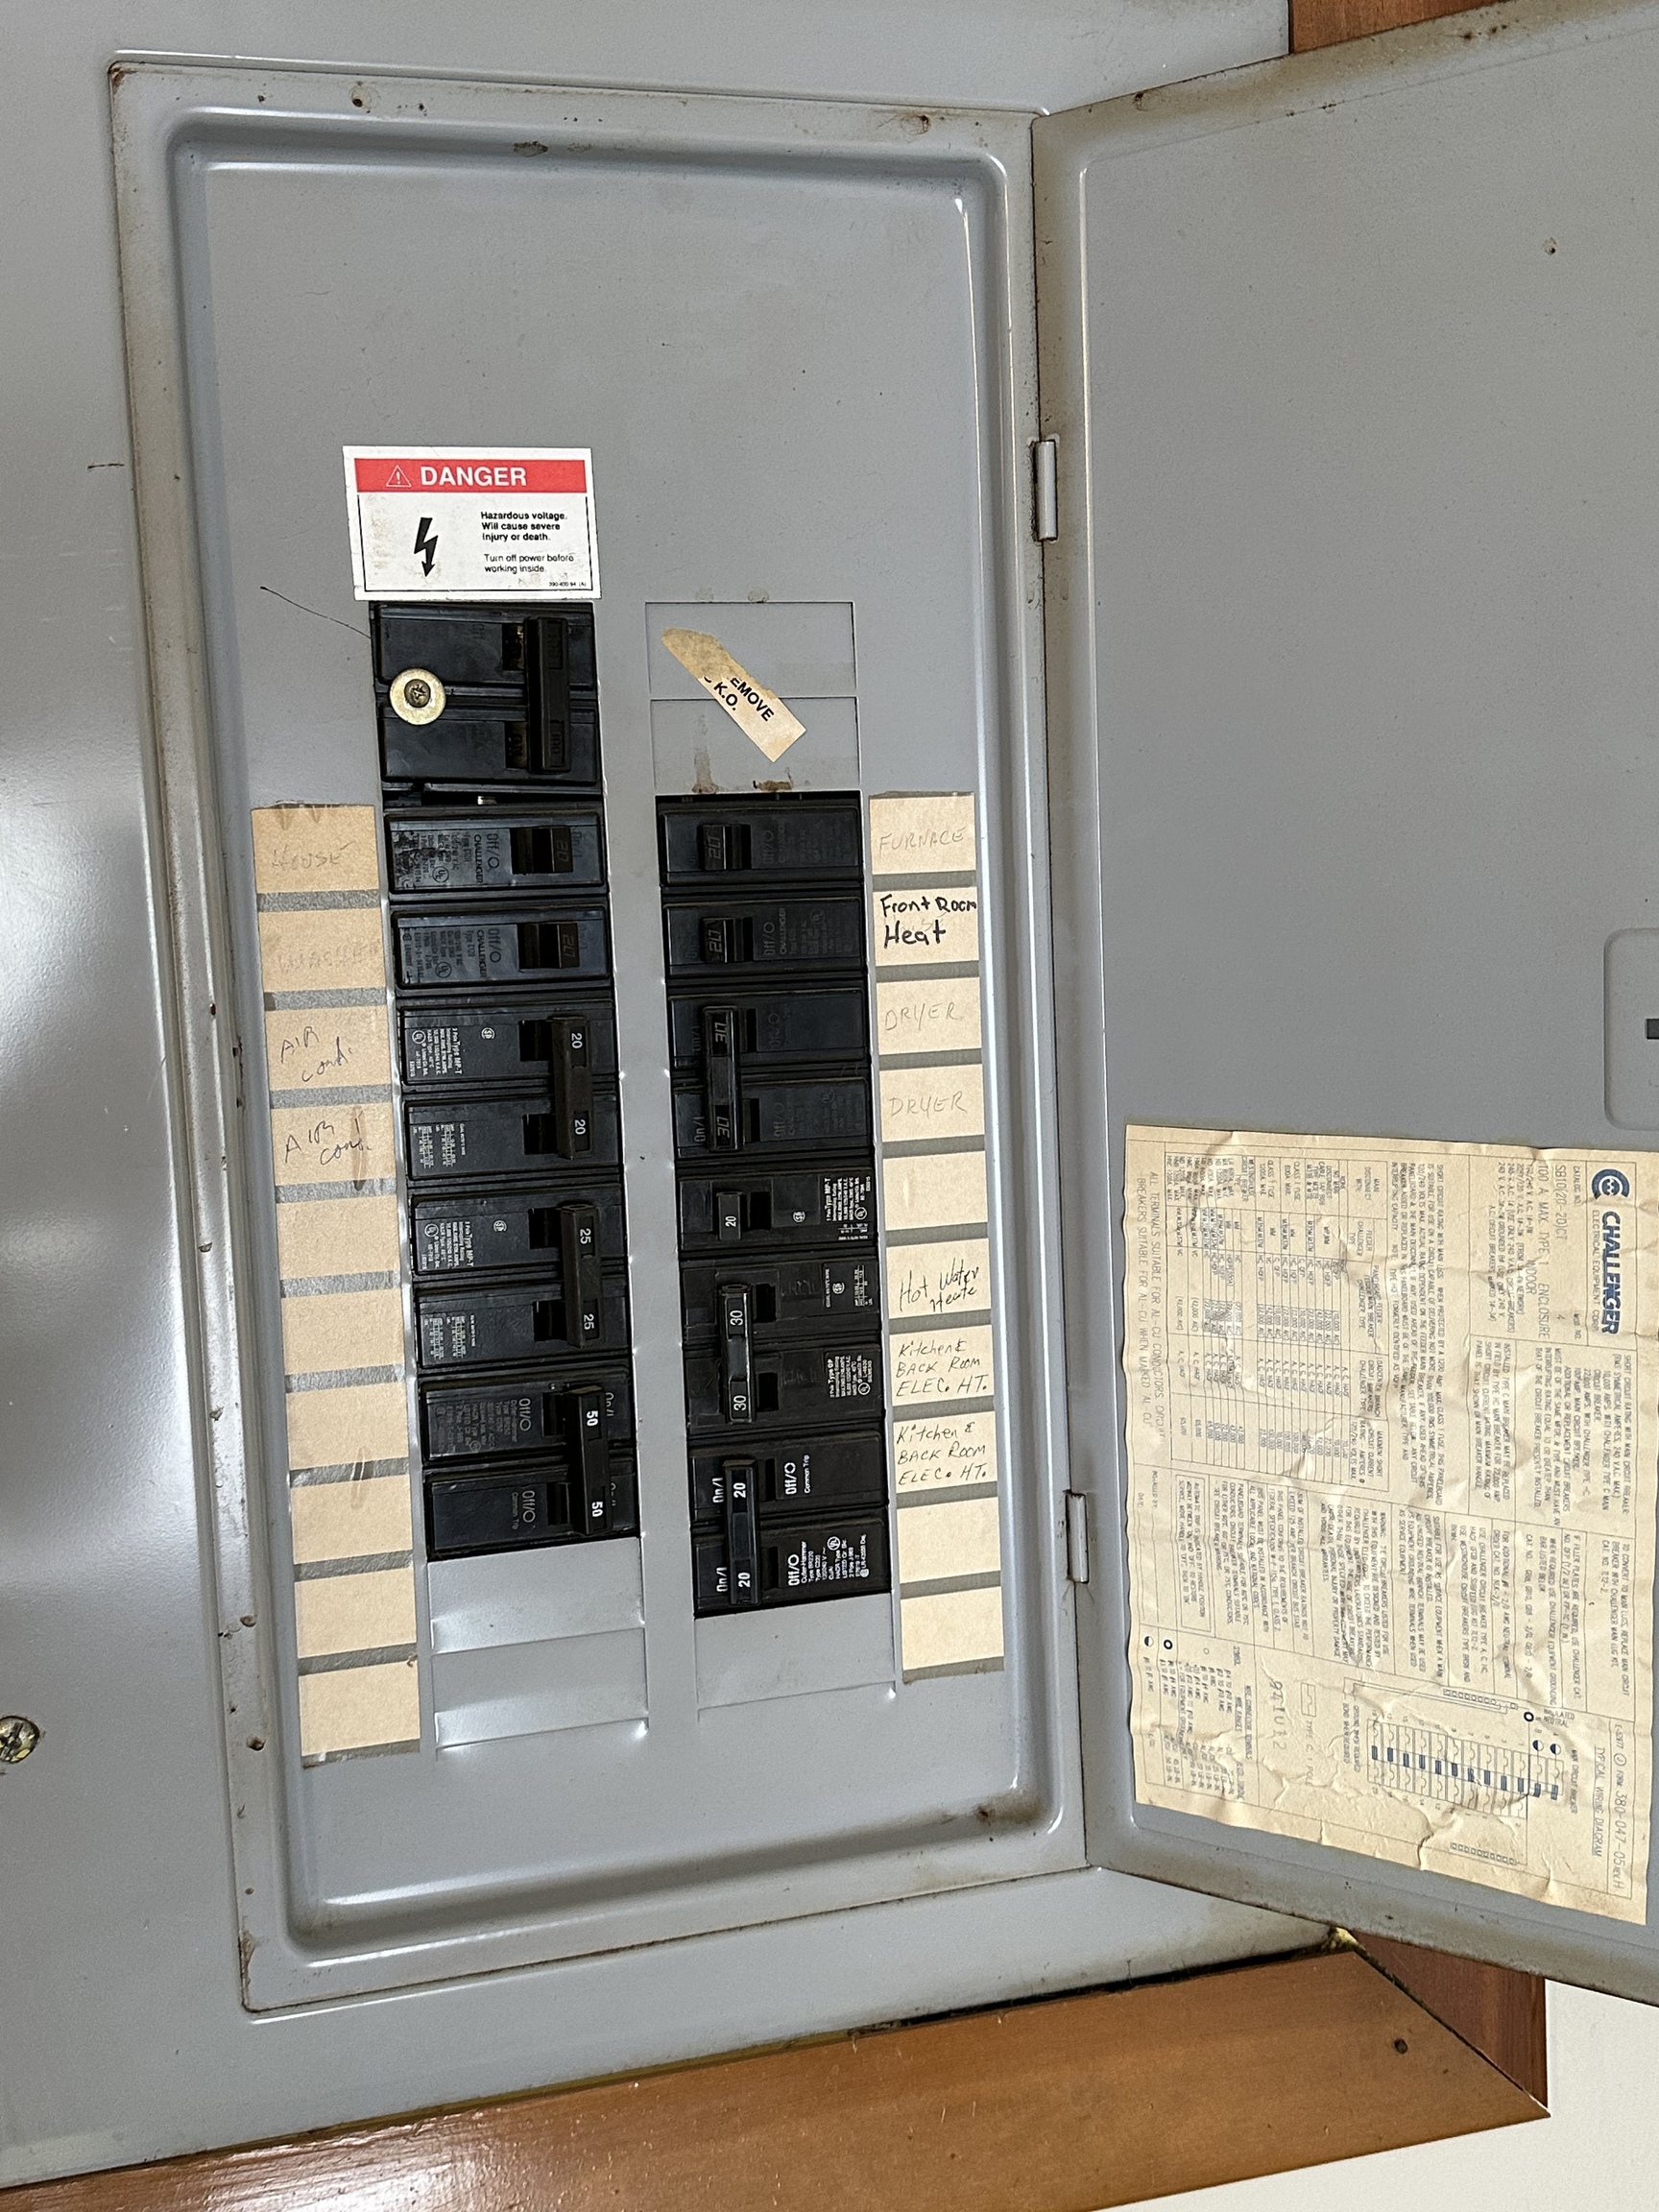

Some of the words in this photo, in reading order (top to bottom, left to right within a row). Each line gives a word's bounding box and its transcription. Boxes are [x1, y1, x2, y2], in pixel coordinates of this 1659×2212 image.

[421, 466, 527, 487] DANGER
[481, 511, 529, 519] Hazardous
[532, 511, 567, 521] voltage.
[481, 521, 498, 530] Will
[522, 532, 551, 541] death.
[484, 553, 504, 562] Turn
[506, 553, 517, 562] off
[519, 555, 544, 564] power
[547, 553, 574, 562] before
[484, 564, 517, 574] working
[519, 564, 546, 573] inside.
[713, 681, 738, 711] K.O.
[729, 676, 775, 722] EMOVE
[556, 840, 568, 863] 20
[708, 836, 721, 859] 20
[878, 826, 966, 854] FURNACE
[473, 833, 484, 884] CHALLENGER
[880, 893, 930, 918] Front
[709, 929, 723, 953] 20
[779, 907, 787, 955] CHALLENGER
[883, 919, 947, 950] Heat
[476, 929, 488, 978] CHALLENGER
[562, 933, 575, 958] 20
[884, 1001, 963, 1032] DRYER
[280, 1026, 320, 1065] AIR
[451, 1040, 461, 1056] Type
[570, 1032, 583, 1049] 20
[453, 1057, 463, 1075] MP-T
[889, 1090, 968, 1119] DRYER
[573, 1118, 587, 1135] 20
[285, 1120, 335, 1164] AIR
[1149, 1171, 1160, 1187] ALL
[1537, 1164, 1550, 1182] 100
[1573, 1166, 1581, 1192] CATALOG
[824, 1177, 832, 1194] MP-T
[824, 1194, 833, 1211] Type
[1136, 1178, 1147, 1222] BREAKERS
[1552, 1164, 1568, 1240] SB10(20-20)CT
[725, 1215, 736, 1228] 20
[1150, 1191, 1162, 1238] TERMINALS
[463, 1233, 473, 1249] Type
[580, 1228, 591, 1245] 25
[1538, 1231, 1550, 1254] TYPE
[1592, 1210, 1600, 1257] ELECTRICAL
[1137, 1226, 1147, 1266] SUITABLE
[1151, 1241, 1162, 1281] SUITABLE
[1601, 1210, 1622, 1335] CHALLENGER
[940, 1257, 979, 1291] Water
[1138, 1270, 1148, 1288] FOR
[1526, 1259, 1537, 1294] INDOOR
[1592, 1260, 1600, 1305] EQUIPMENT
[899, 1269, 928, 1312] Hot
[1152, 1286, 1162, 1304] FOR
[730, 1310, 743, 1326] 30
[1138, 1292, 1149, 1322] AL-CU
[1538, 1283, 1551, 1339] ENCLOSURE
[583, 1313, 595, 1331] 25
[1152, 1309, 1163, 1338] AL-CU
[898, 1338, 952, 1358] Kitchen
[1138, 1327, 1149, 1351] WHEN
[896, 1360, 938, 1379] BACK
[1138, 1355, 1150, 1388] MARKED
[1623, 1355, 1632, 1375] SHORT
[896, 1377, 950, 1397] ELEC.
[957, 1374, 989, 1395] HT.
[1623, 1377, 1632, 1400] CIRCUIT
[733, 1395, 747, 1411] 30
[1623, 1402, 1632, 1424] RATING
[586, 1410, 599, 1427] 50
[896, 1423, 958, 1445] Kitchen
[1623, 1427, 1631, 1441] WITH
[803, 1455, 811, 1469] Trip
[898, 1449, 942, 1466] BACK
[1623, 1443, 1631, 1458] MAIN
[898, 1467, 952, 1486] ELEC.
[960, 1463, 988, 1481] HT.
[1623, 1460, 1631, 1484] CIRCUIT
[733, 1482, 746, 1499] 20
[591, 1501, 604, 1517] 50
[512, 1518, 520, 1530] Trip
[738, 1572, 751, 1588] 20
[1269, 1680, 1286, 1750] 941012
[1596, 1746, 1606, 1780] TYPICAL
[1570, 1764, 1579, 1788] CIRCUIT
[1595, 1786, 1605, 1814] WIRING
[1593, 1816, 1604, 1858] DIAGRAM
[1613, 1790, 1628, 1865] 380-047-05
[1613, 1880, 1623, 1888] H
